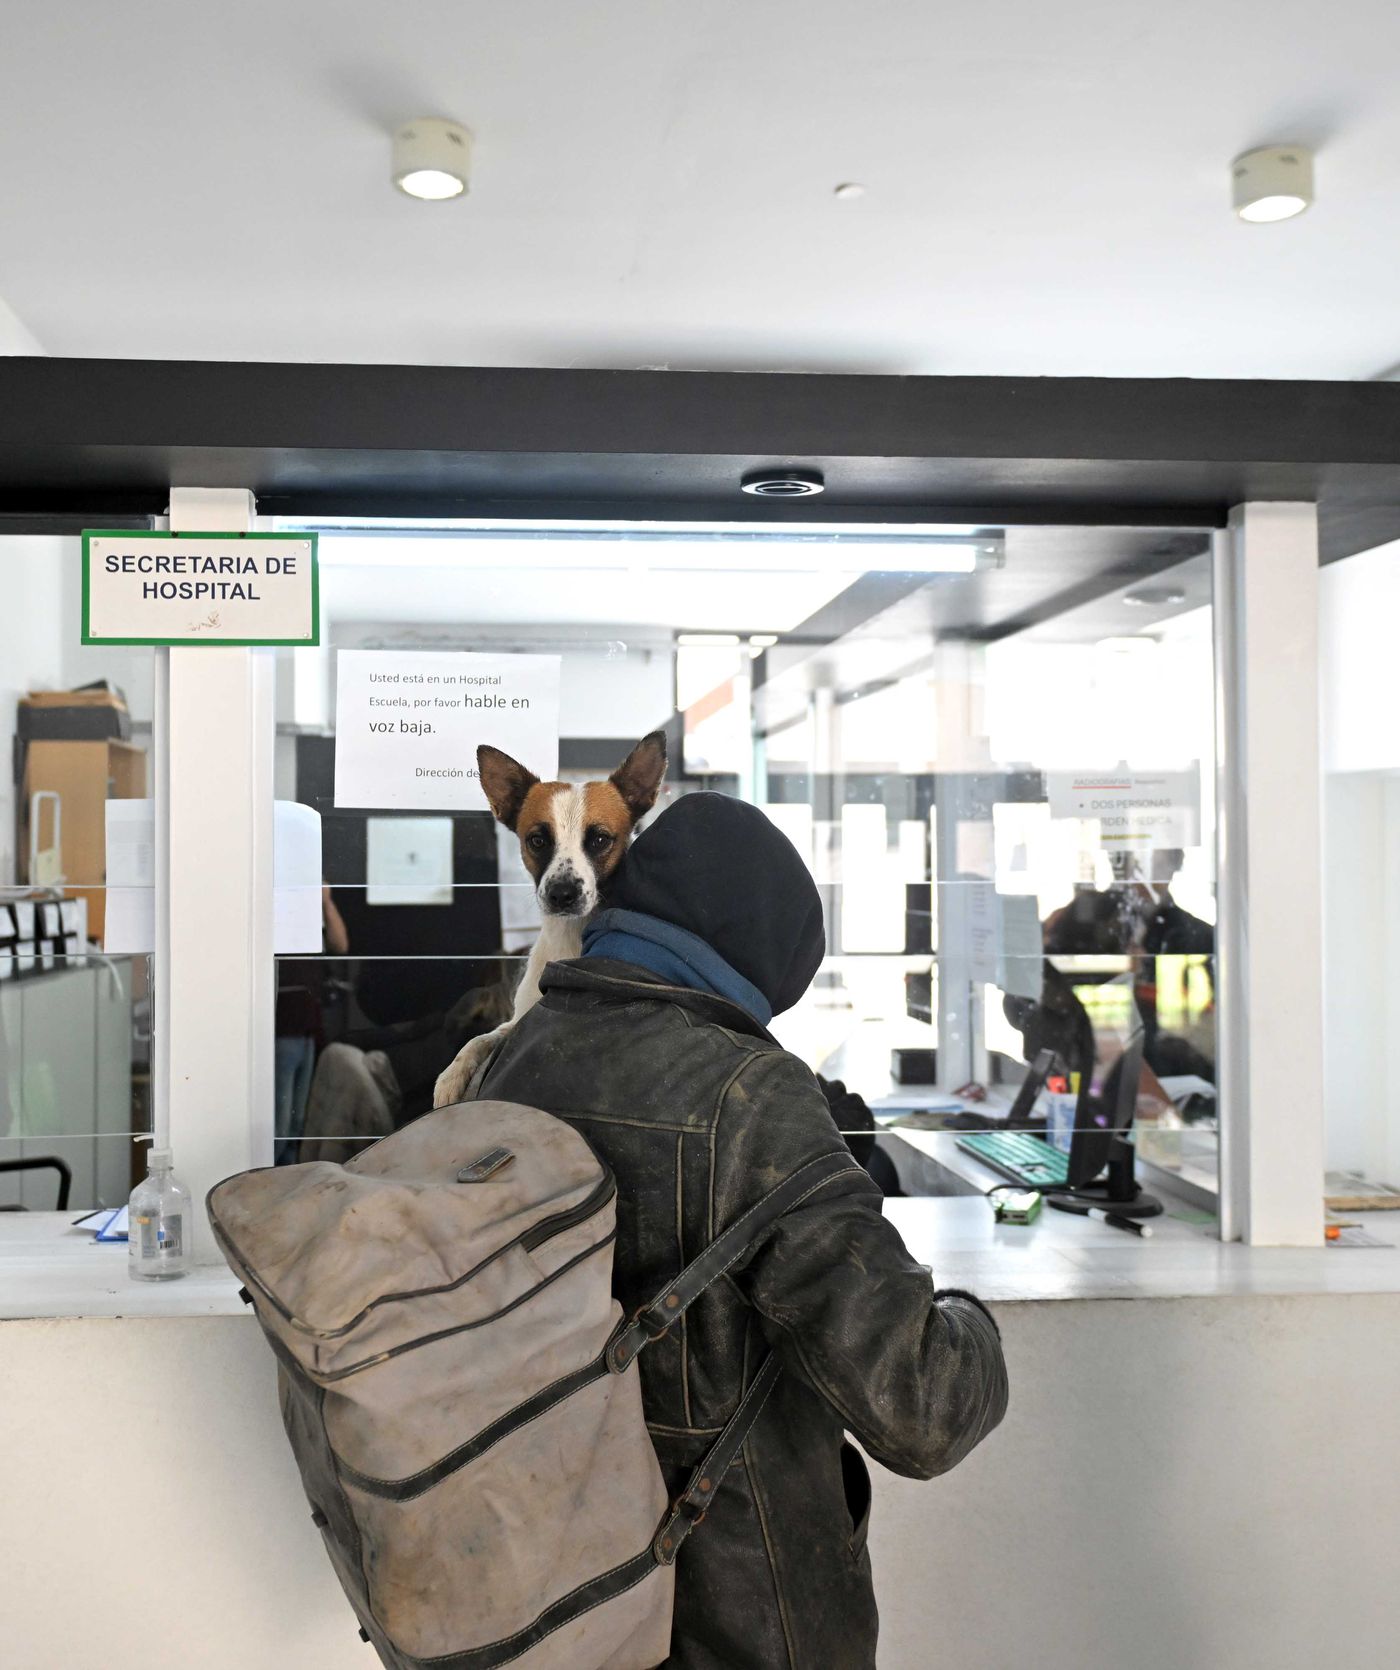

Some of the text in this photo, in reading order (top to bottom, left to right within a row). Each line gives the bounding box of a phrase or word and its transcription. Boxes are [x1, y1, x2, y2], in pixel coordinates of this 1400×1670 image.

[105, 555, 297, 575] SECRETARIA DE
[142, 581, 261, 600] HOSPITAL
[369, 673, 502, 687] Usted está en un Hospital
[369, 693, 530, 709] Escuela, por favor hable en
[369, 719, 437, 737] voz baja.
[415, 767, 464, 778] Dirección
[1090, 798, 1172, 810] DOS PERSONAS
[1099, 816, 1129, 827] RDEN
